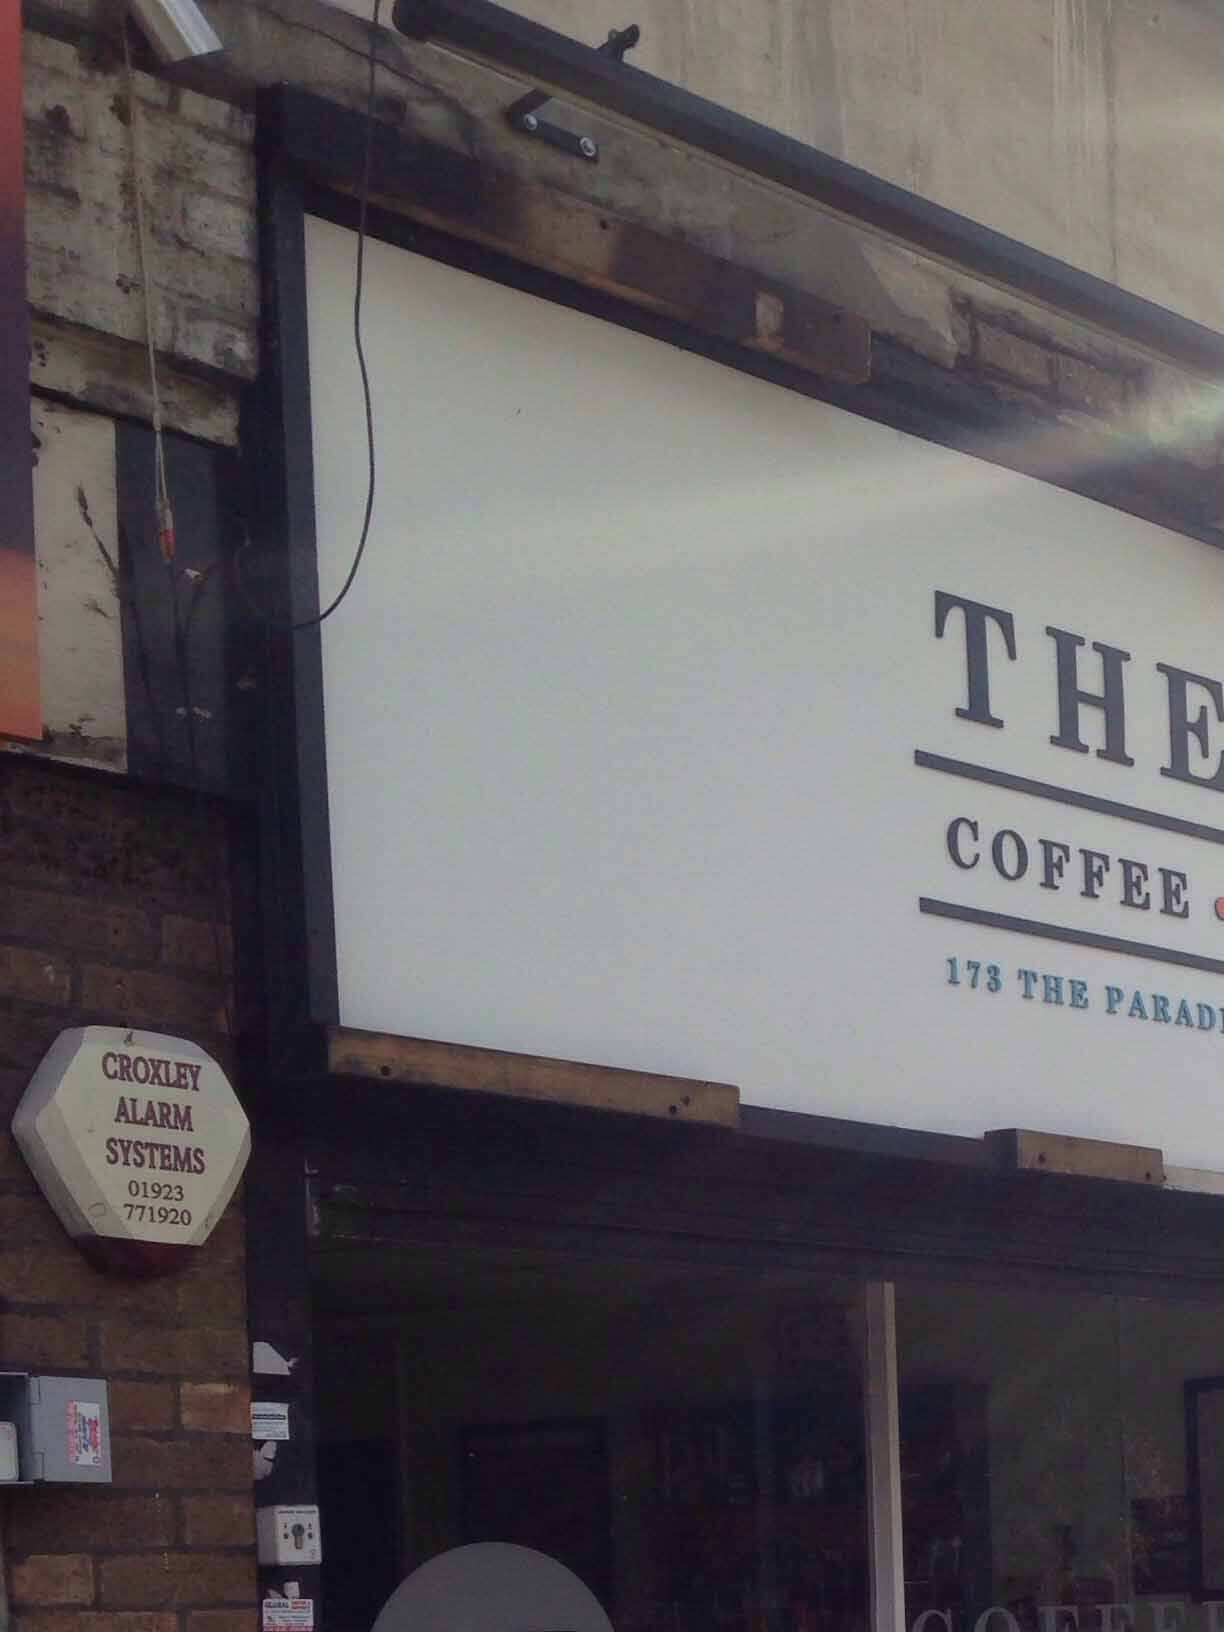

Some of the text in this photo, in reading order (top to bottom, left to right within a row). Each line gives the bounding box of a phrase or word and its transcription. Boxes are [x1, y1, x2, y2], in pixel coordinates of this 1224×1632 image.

[946, 816, 1191, 919] COFFEE
[946, 957, 1002, 994] 173
[1018, 967, 1089, 1012] THE
[102, 1052, 201, 1091] CROXLEY
[114, 1096, 194, 1132] ALARM
[105, 1137, 205, 1175] SYSTEMS
[128, 1180, 184, 1201] 01923
[124, 1203, 192, 1226] 771920
